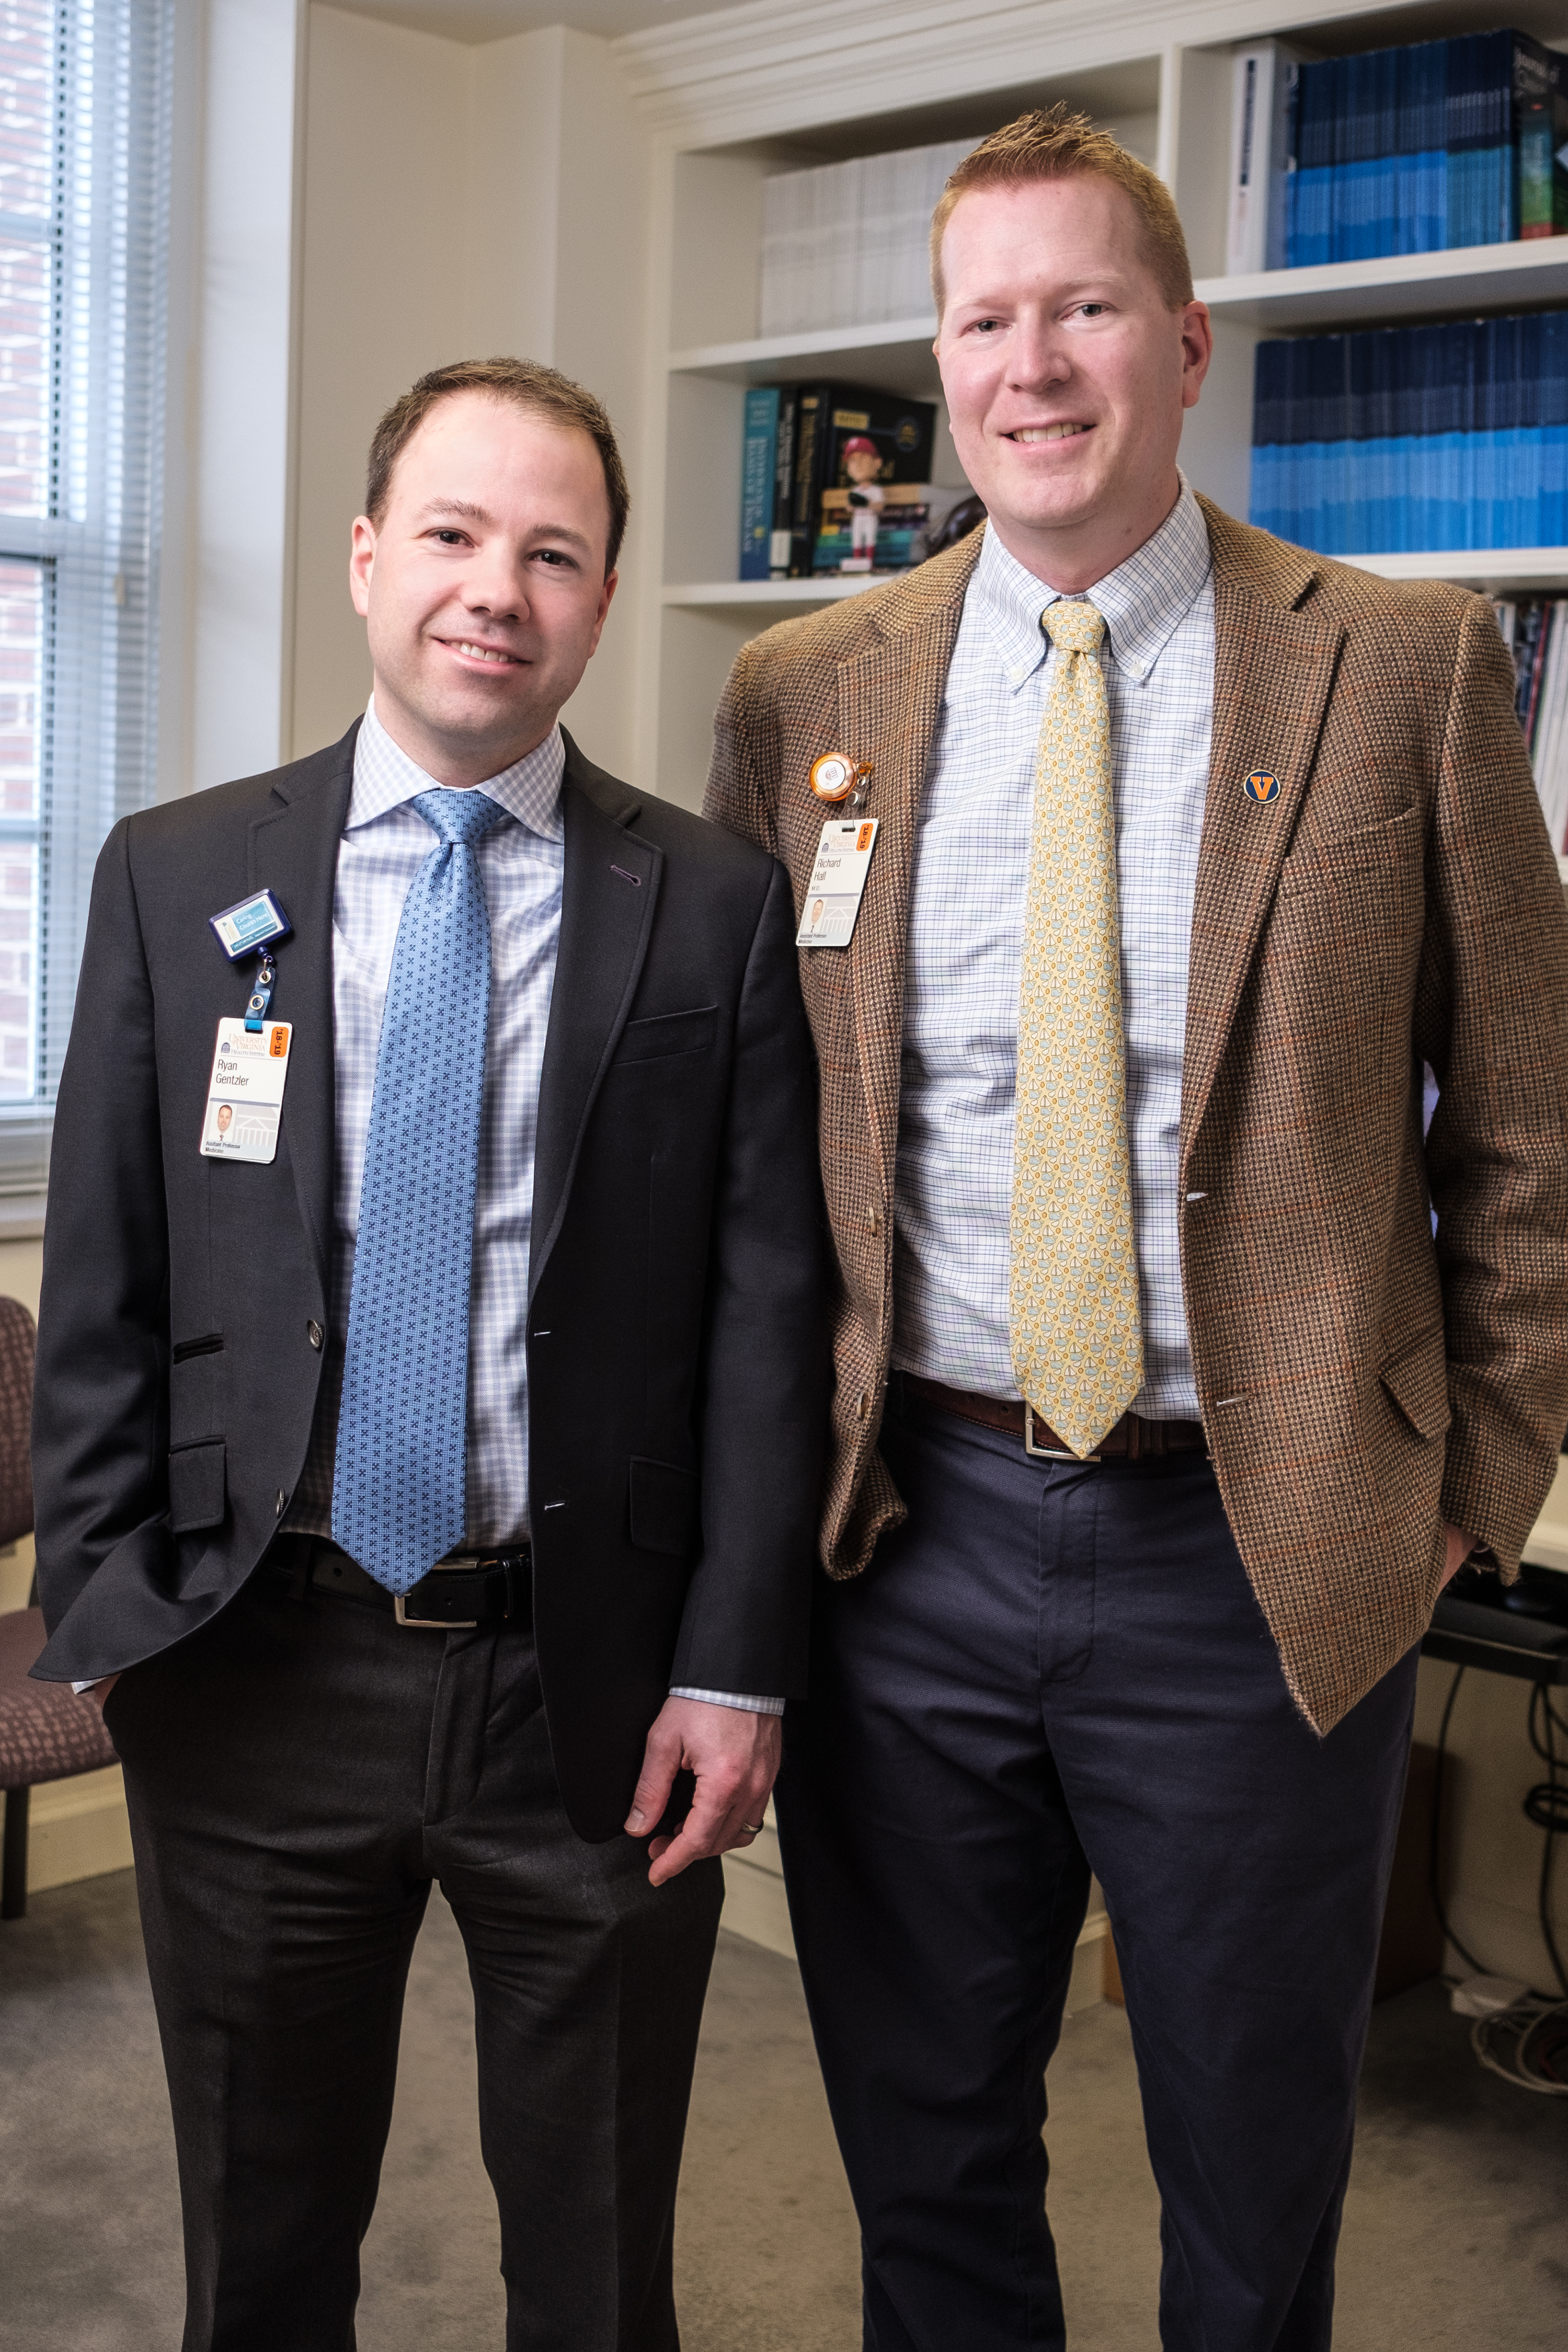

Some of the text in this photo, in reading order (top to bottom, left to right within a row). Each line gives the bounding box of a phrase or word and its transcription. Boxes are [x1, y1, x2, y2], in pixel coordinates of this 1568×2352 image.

[1250, 776, 1274, 800] V
[817, 858, 841, 868] Richard
[814, 871, 826, 881] Hall
[236, 914, 252, 924] Caring
[239, 918, 257, 930] Counts
[217, 1059, 237, 1071] Ryan
[216, 1073, 249, 1086] Gentzler
